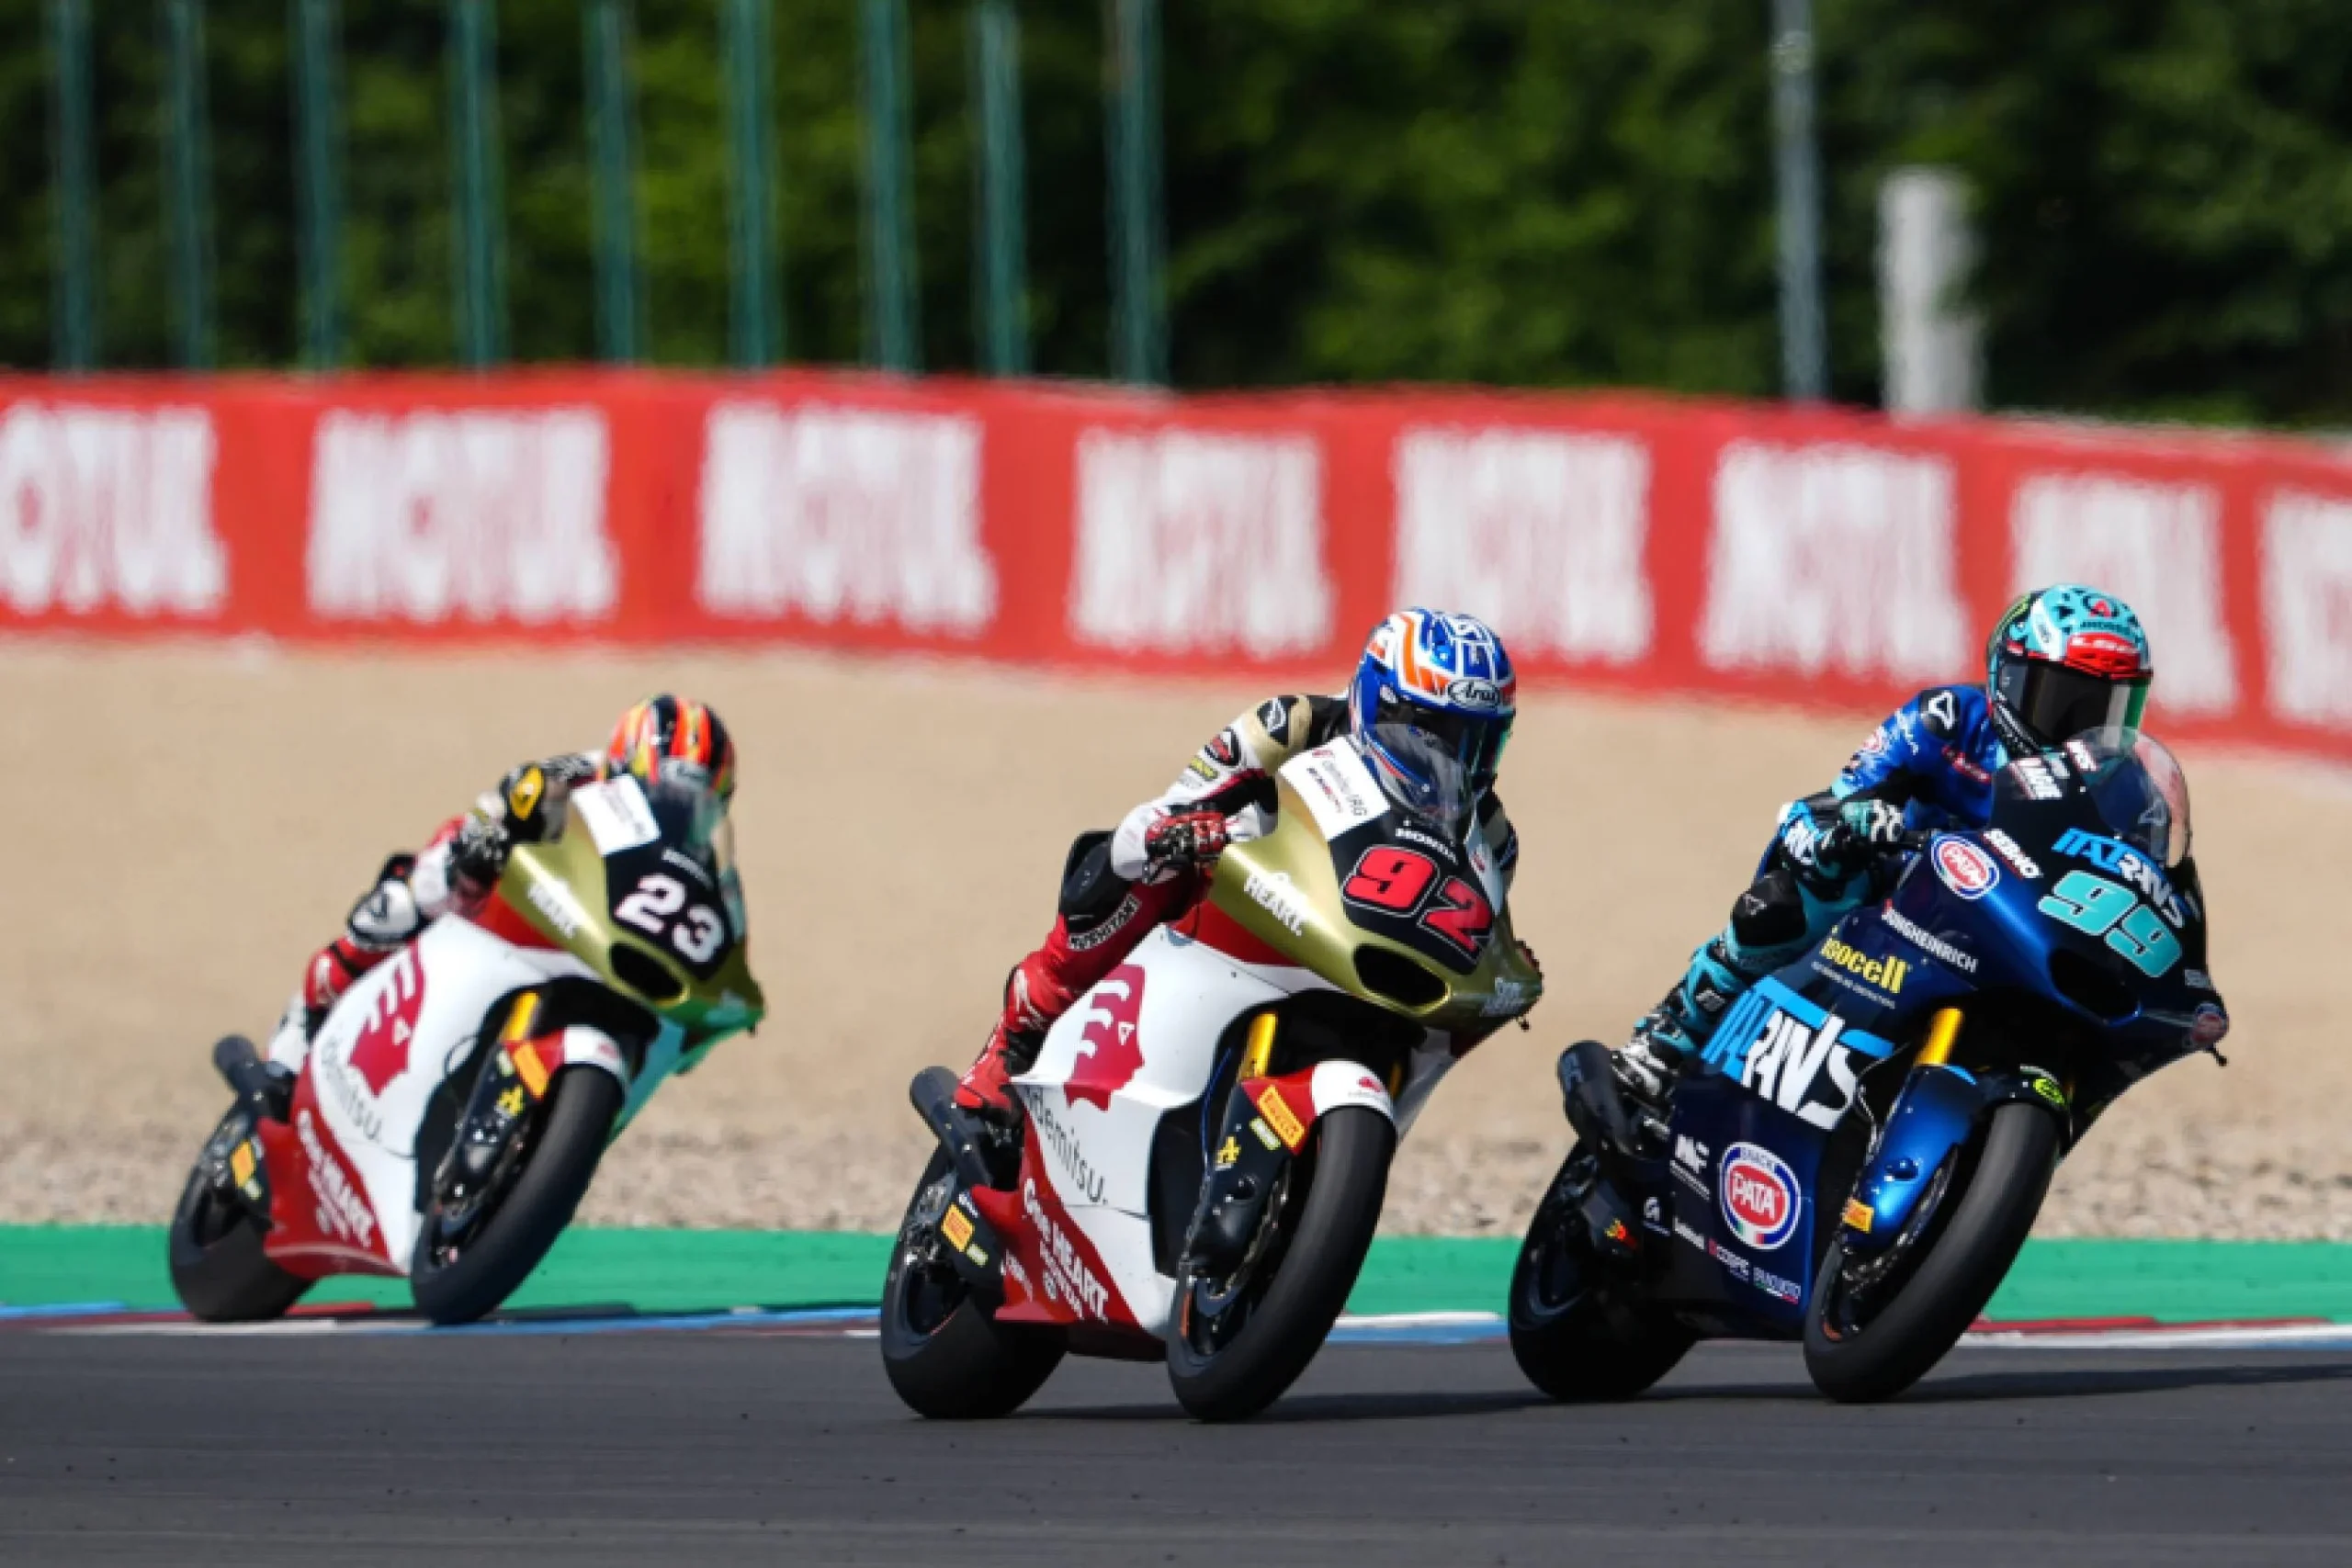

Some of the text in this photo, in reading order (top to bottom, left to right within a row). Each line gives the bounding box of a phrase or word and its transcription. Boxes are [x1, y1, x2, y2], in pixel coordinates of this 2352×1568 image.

[614, 874, 725, 964] 23
[1342, 844, 1494, 963] 92
[2036, 869, 2183, 978] 99
[1733, 1170, 1777, 1220] PATA
